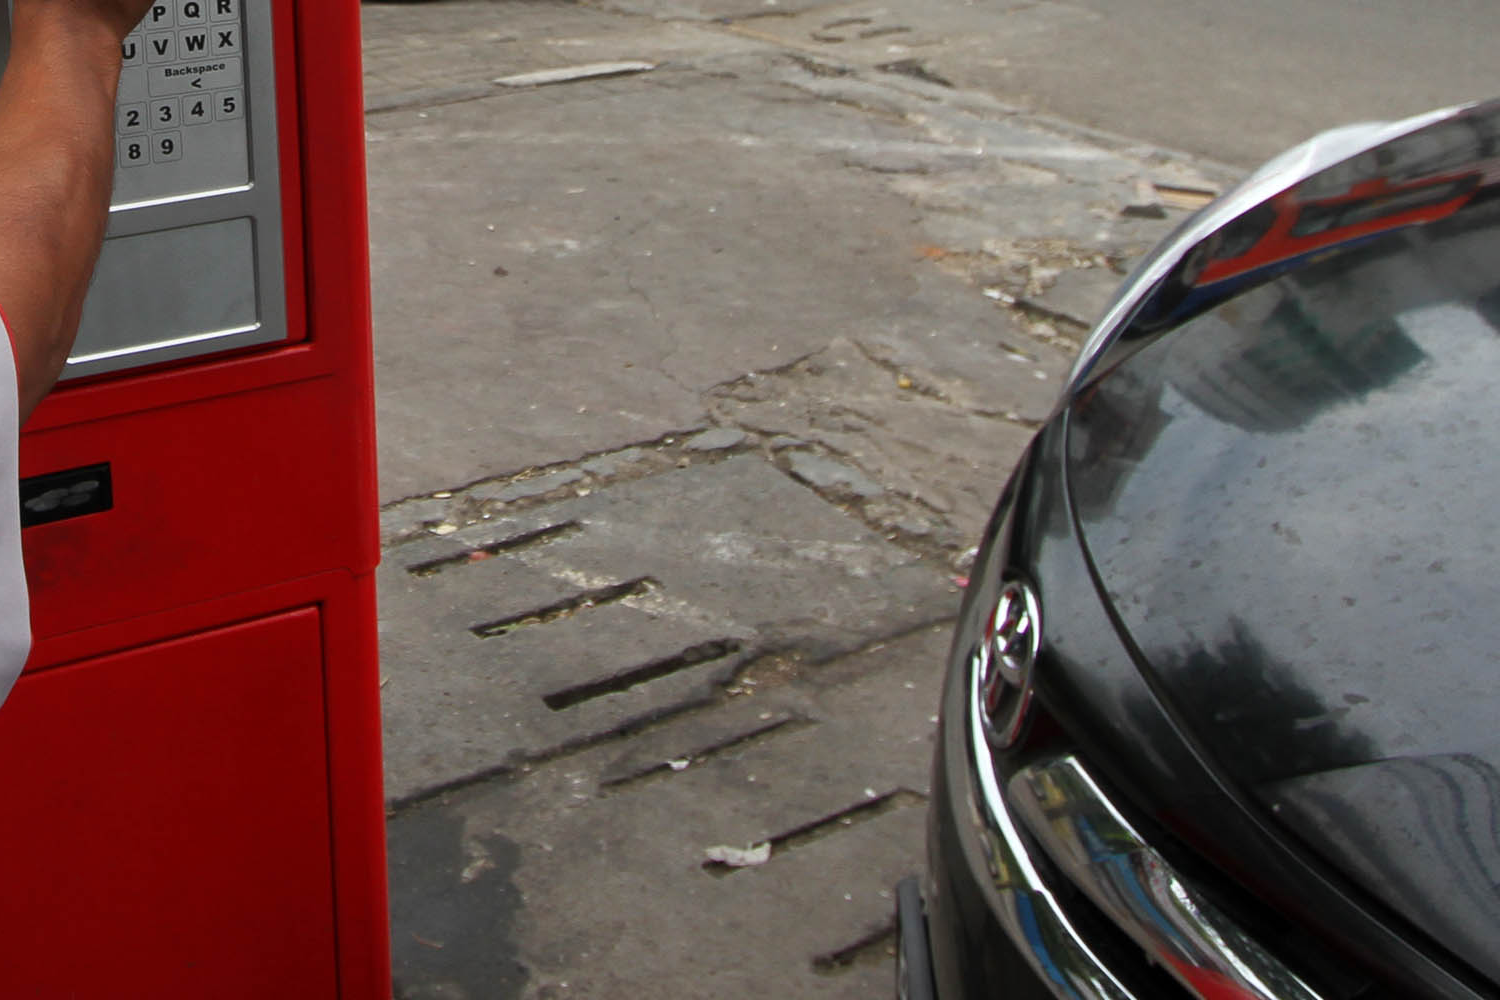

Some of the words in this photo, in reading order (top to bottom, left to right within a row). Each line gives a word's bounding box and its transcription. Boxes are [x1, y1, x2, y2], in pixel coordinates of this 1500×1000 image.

[153, 6, 167, 23] P
[184, 1, 201, 20] Q
[122, 43, 136, 60] U
[153, 39, 169, 56] V
[185, 34, 206, 52] W
[218, 31, 234, 48] X
[164, 61, 226, 78] Backspace
[126, 110, 140, 127] 2
[159, 106, 173, 123] 3
[190, 101, 205, 117] 4
[223, 97, 236, 114] 5
[128, 143, 141, 160] 8
[160, 138, 174, 155] 9
